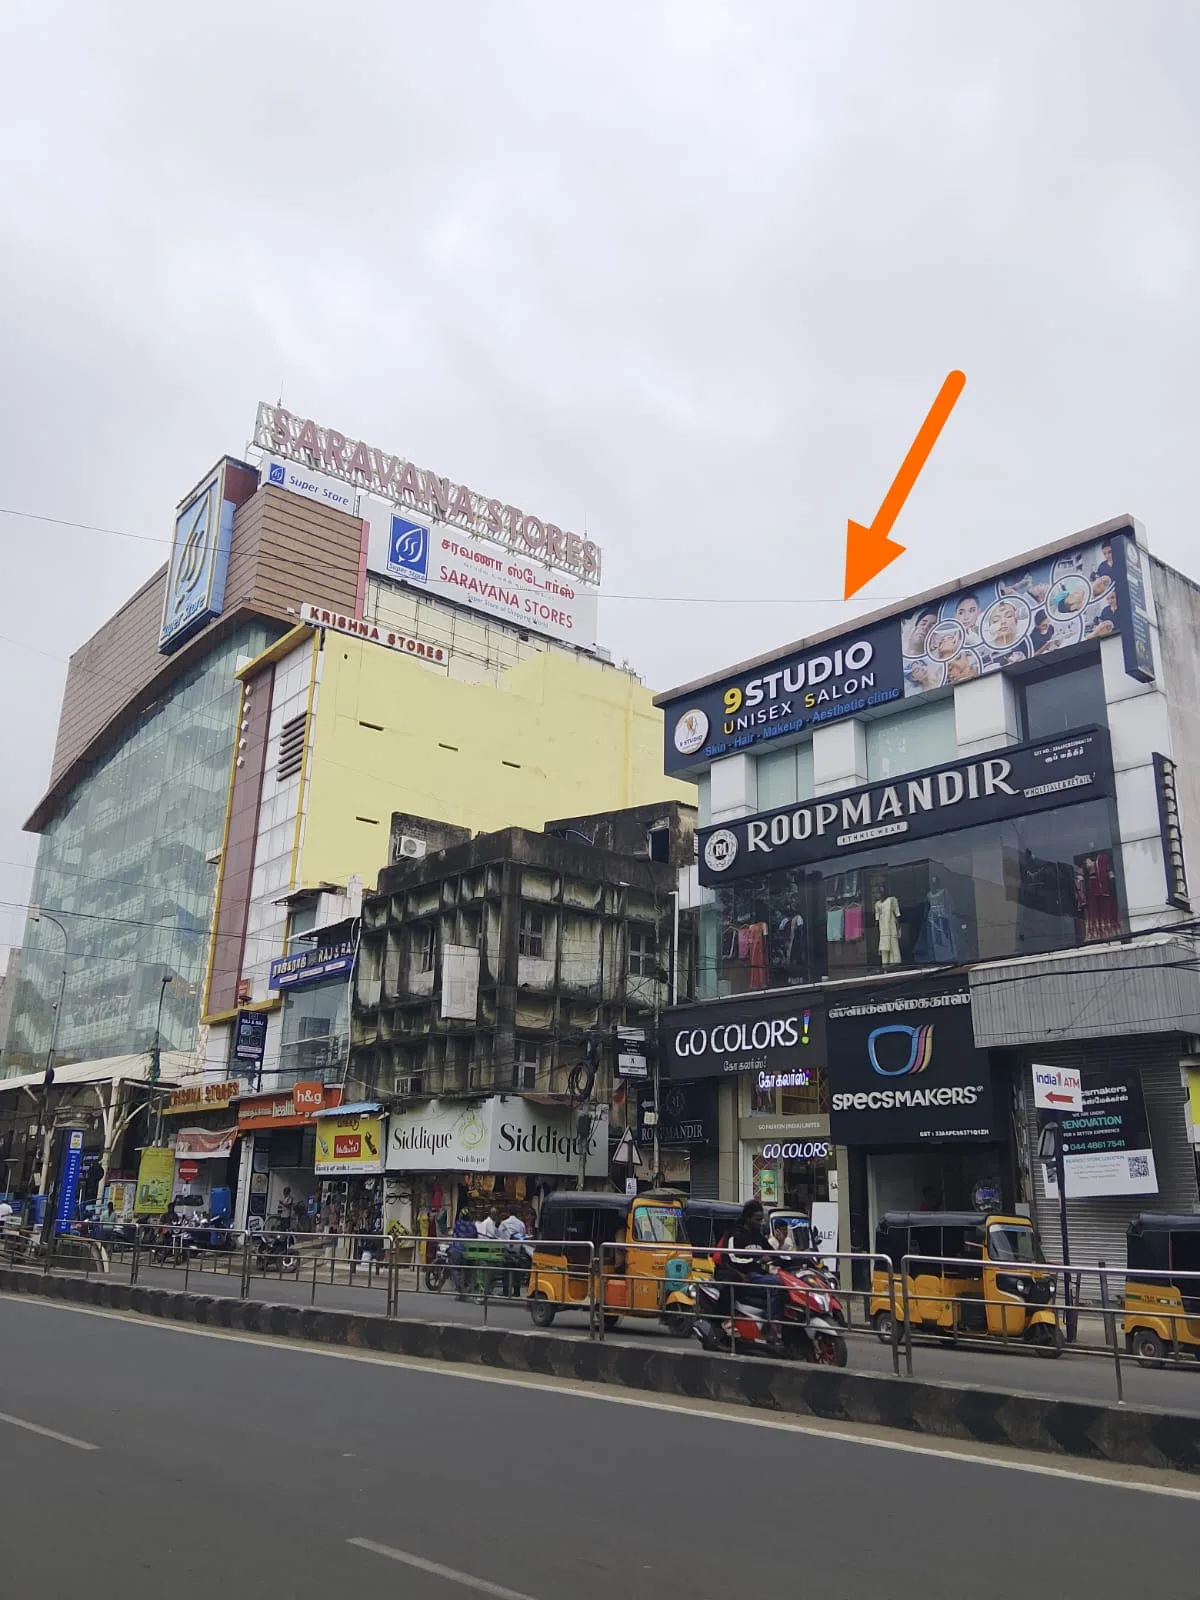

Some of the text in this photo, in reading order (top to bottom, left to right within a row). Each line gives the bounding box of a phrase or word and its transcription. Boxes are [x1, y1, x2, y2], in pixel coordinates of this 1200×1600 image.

[271, 408, 598, 573] SARAVANA STORES
[288, 475, 350, 506] Super Store
[441, 538, 503, 572] சரவணா
[507, 563, 575, 601] ஸ்டோர்ஸ்
[439, 565, 520, 609] SARAVANA
[524, 599, 573, 629] STORES
[309, 606, 444, 662] KRISHNA STORES
[722, 671, 876, 736] UNISEX SALON
[703, 742, 727, 758] Skin
[734, 734, 753, 749] Hair
[762, 719, 803, 740] Makeup
[812, 697, 865, 722] Aesthetic
[866, 688, 900, 705] clinic
[746, 758, 1021, 854] ROOPMANDIR
[318, 946, 333, 963] RAJ
[675, 1028, 708, 1057] GO
[296, 1089, 322, 1105] h&g
[1064, 1076, 1080, 1089] ATM
[392, 1126, 453, 1156] Siddique
[641, 1124, 703, 1141] ROPMANDIR
[762, 1143, 781, 1159] GO
